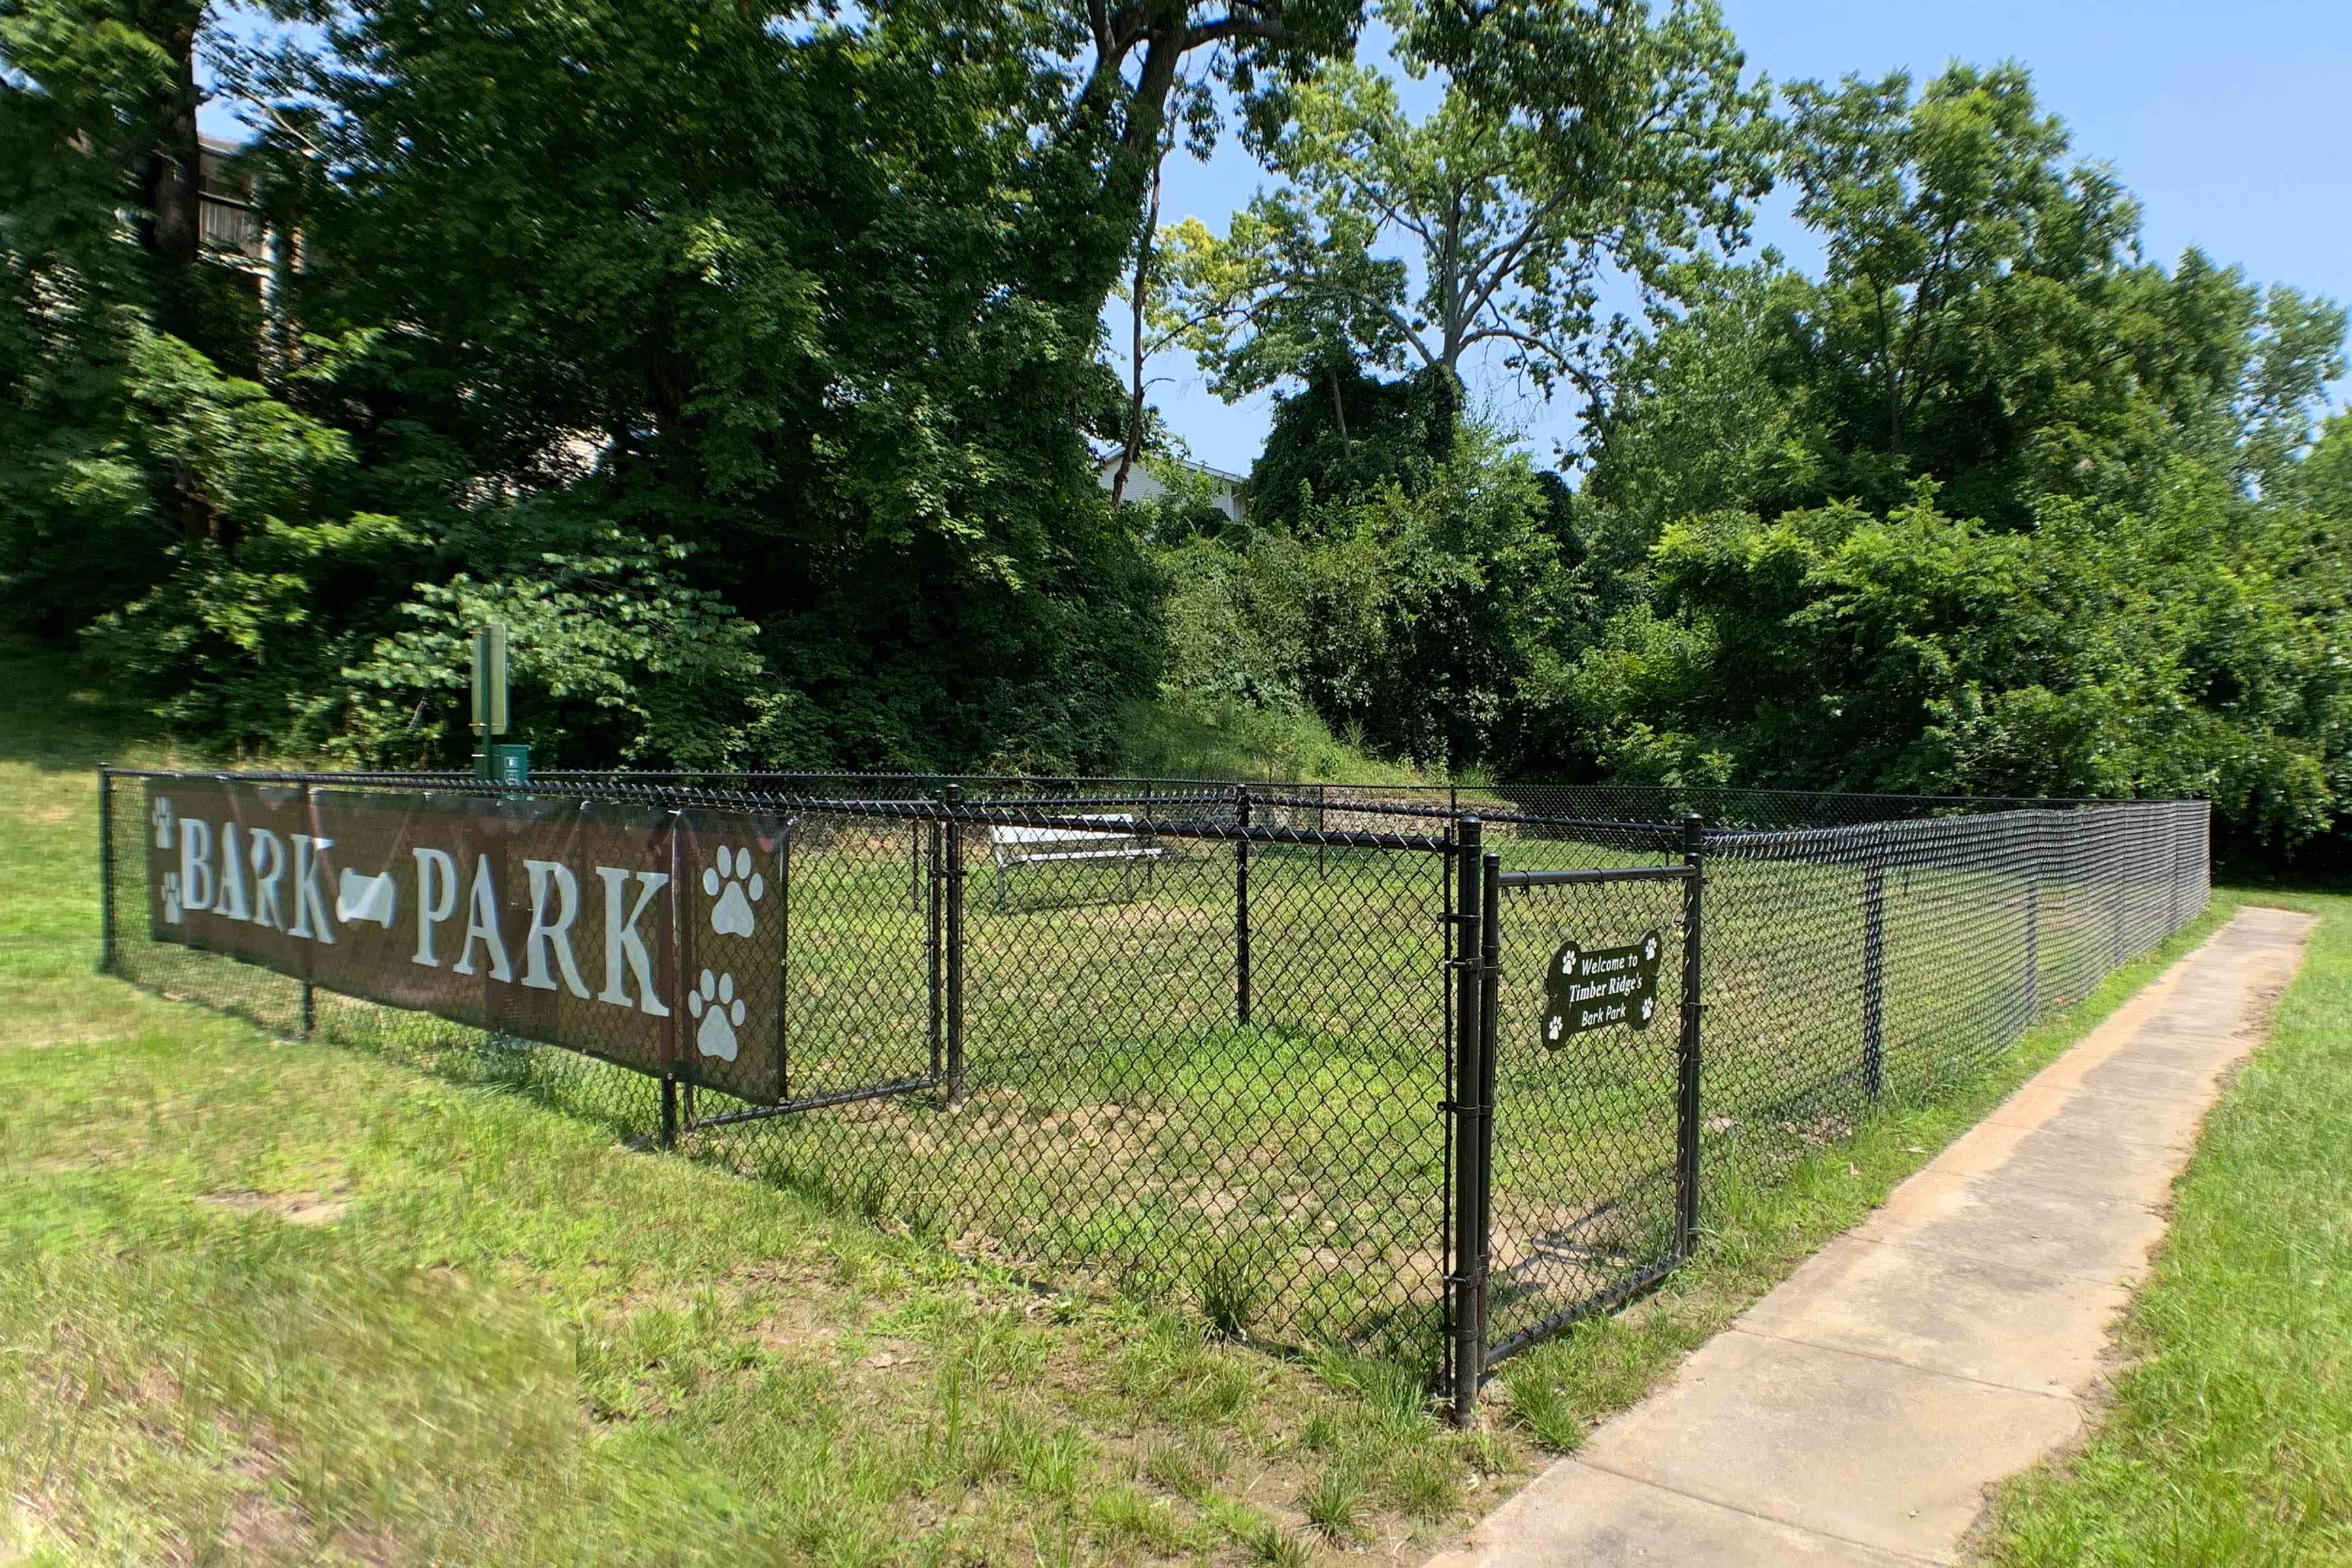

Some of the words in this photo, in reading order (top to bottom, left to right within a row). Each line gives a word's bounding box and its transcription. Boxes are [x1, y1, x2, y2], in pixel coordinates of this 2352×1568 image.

[179, 818, 335, 945] BARK
[411, 847, 670, 1017] PARK
[1581, 956, 1625, 976] Welcome
[1628, 953, 1638, 968] to
[1569, 981, 1607, 1002] Timber
[1608, 972, 1642, 996] Ridge's
[1581, 1007, 1603, 1027] Bark
[1605, 1002, 1626, 1021] Park
